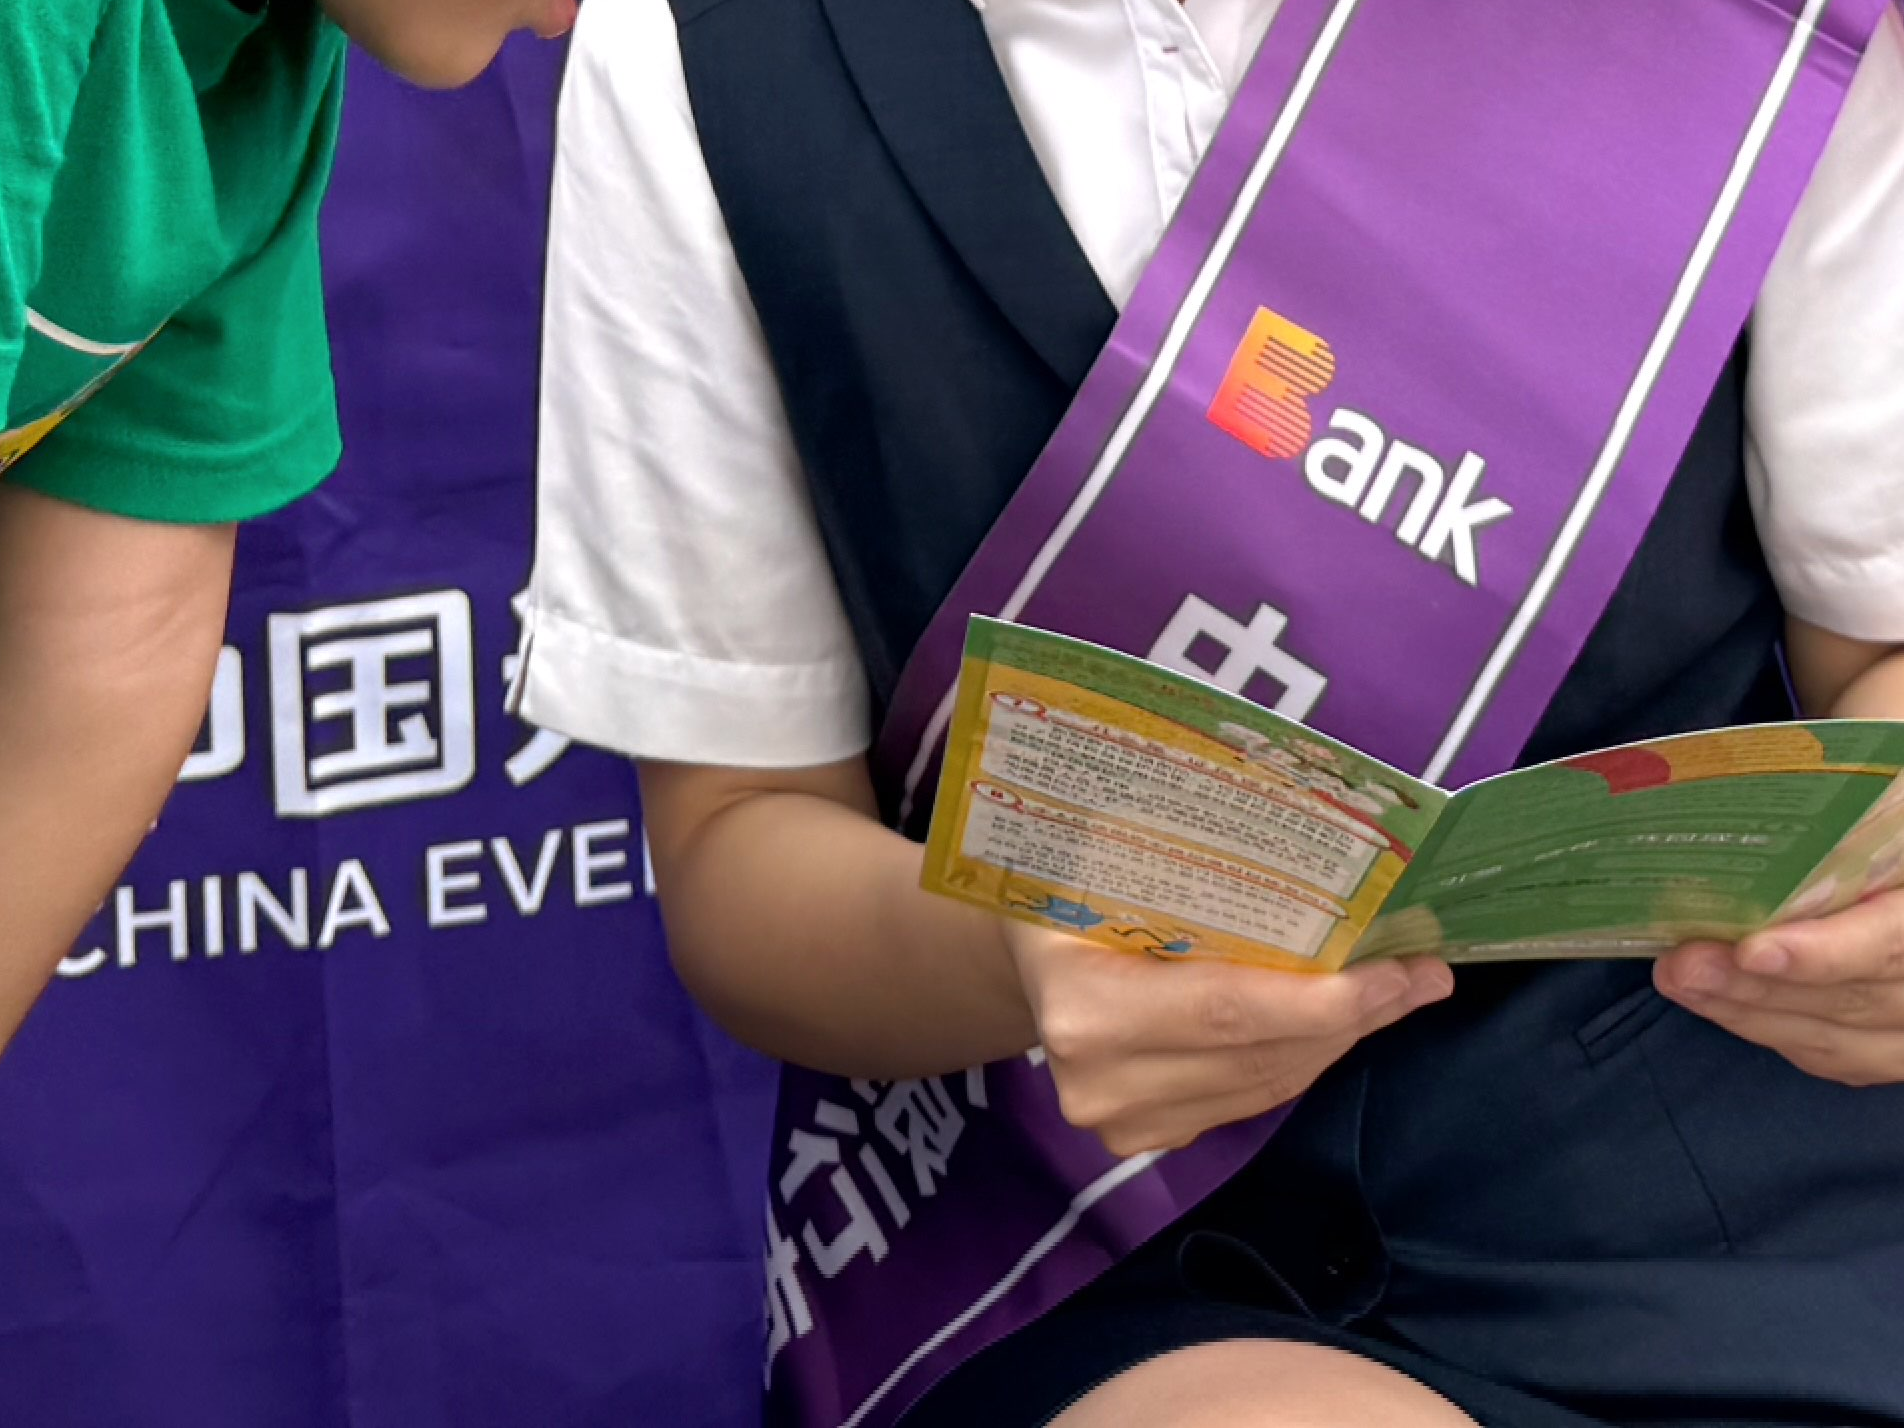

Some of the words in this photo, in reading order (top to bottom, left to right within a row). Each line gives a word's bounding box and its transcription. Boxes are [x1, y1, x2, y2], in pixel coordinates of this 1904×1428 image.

[1206, 304, 1514, 587] Bank
[55, 859, 391, 976] HINA
[425, 818, 656, 927] EVE
